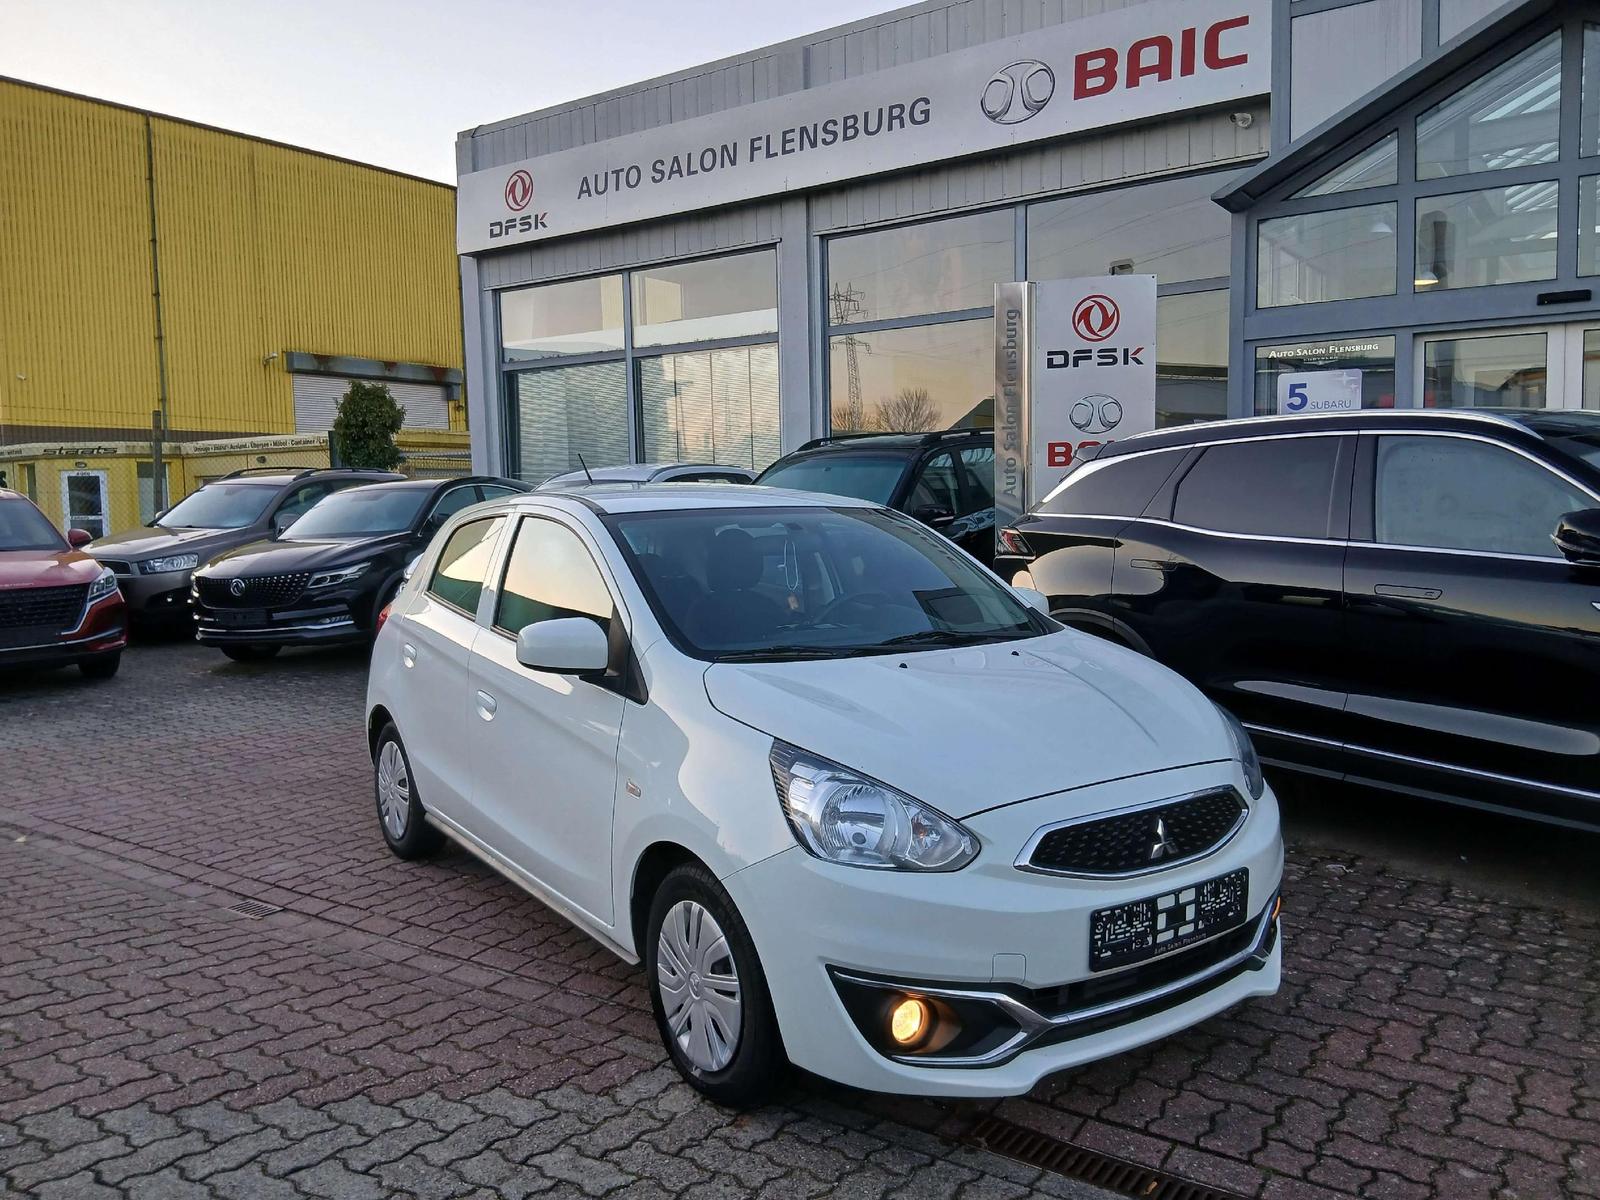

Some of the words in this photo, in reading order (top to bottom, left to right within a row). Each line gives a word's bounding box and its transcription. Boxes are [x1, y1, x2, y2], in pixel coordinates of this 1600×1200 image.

[1073, 15, 1249, 100] BAIC
[577, 164, 642, 200] AUTO
[650, 142, 738, 184] SALON
[749, 96, 931, 163] FLENSBURG
[489, 211, 548, 239] DFSK
[1046, 346, 1145, 369] DFSK
[1268, 350, 1294, 358] AUTO
[1296, 347, 1326, 356] SALON
[1329, 343, 1379, 353] FLENSBURG
[1286, 382, 1308, 411] 5
[1310, 399, 1352, 409] SUBARU
[1001, 405, 1017, 451] Salon
[1002, 457, 1017, 498] Auto
